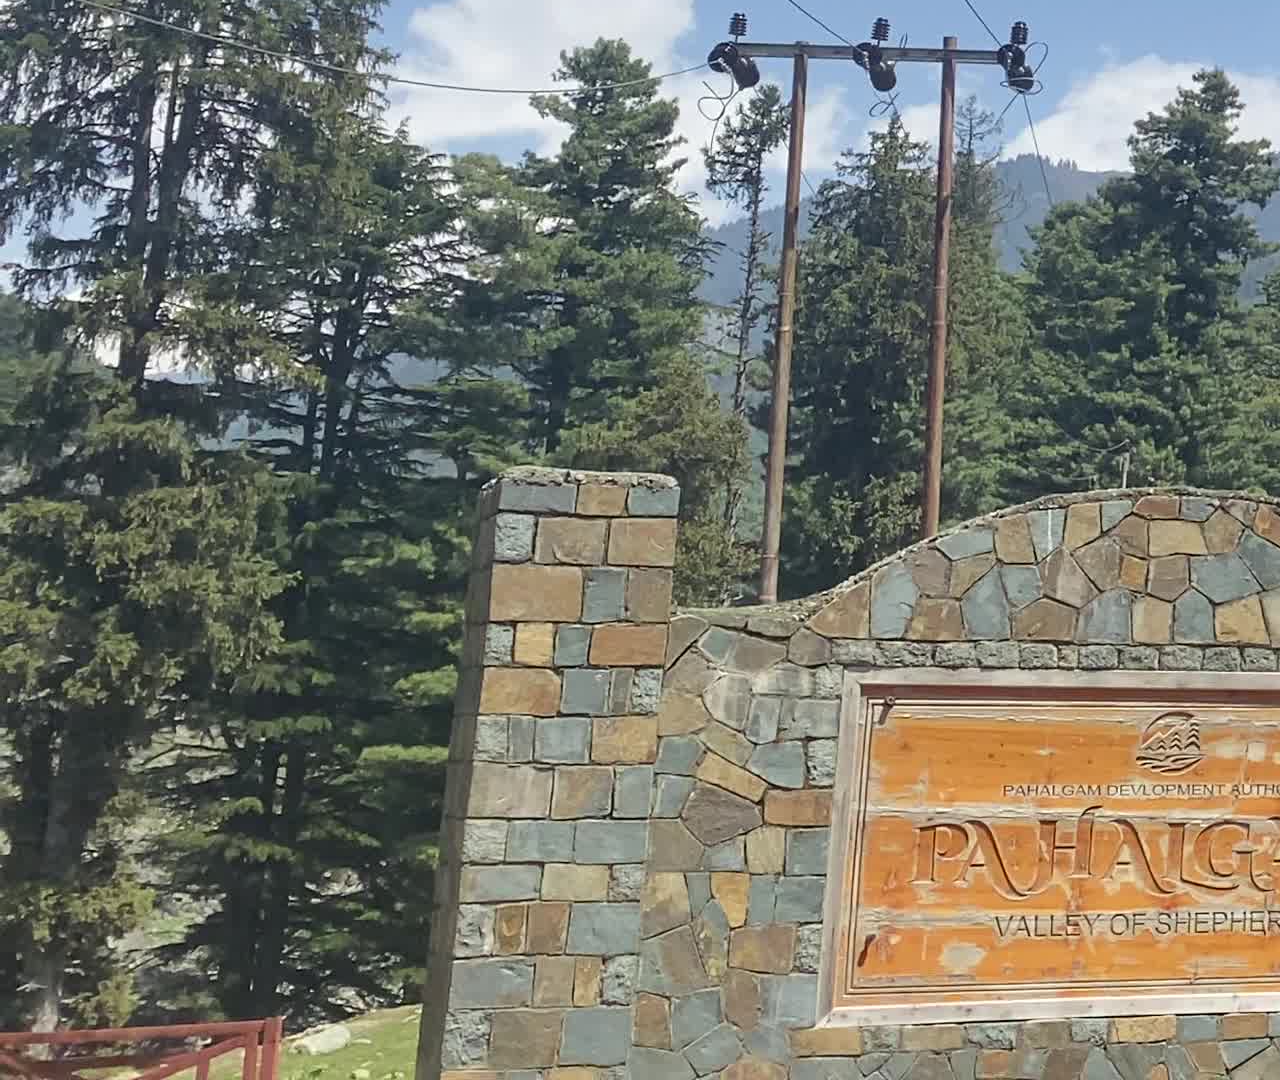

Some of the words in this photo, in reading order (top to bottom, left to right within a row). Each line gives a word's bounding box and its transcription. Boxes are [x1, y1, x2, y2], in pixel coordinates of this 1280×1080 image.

[1002, 783, 1102, 797] PAHALGAM
[1106, 783, 1227, 797] DEVLOPMENT
[994, 913, 1102, 938] VALLEY
[1110, 912, 1148, 937] OF
